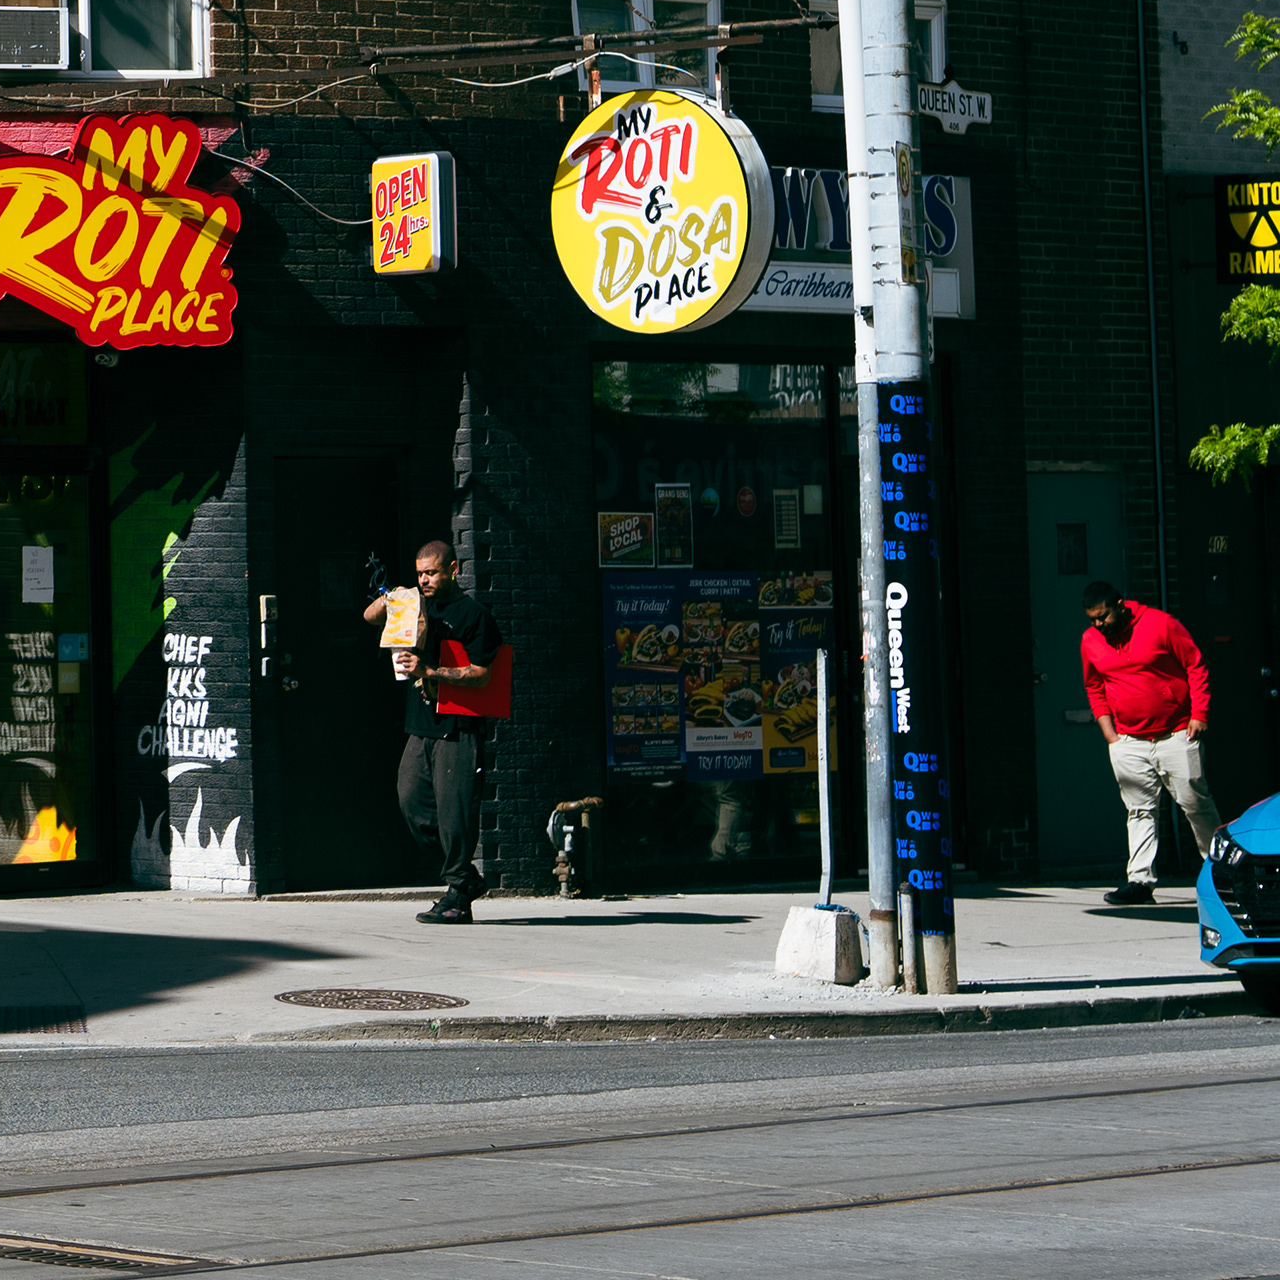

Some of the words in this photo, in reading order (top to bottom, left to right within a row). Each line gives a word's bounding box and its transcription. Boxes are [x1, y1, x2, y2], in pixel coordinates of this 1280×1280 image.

[920, 88, 955, 113] QUEEN
[959, 94, 974, 117] ST.
[977, 96, 987, 119] W.
[617, 107, 652, 140] MY
[949, 122, 959, 131] 406
[82, 125, 188, 193] MY
[571, 122, 693, 214] ROTI
[375, 162, 427, 221] OPEN
[645, 185, 672, 223] &
[380, 213, 412, 267] 24
[409, 215, 429, 234] hrs.
[599, 202, 731, 302] DOSA
[765, 270, 854, 299] Caribbean
[90, 286, 223, 336] PLACE
[610, 516, 640, 537] SHOP
[610, 528, 643, 551] LOCAL
[689, 579, 702, 587] JERK
[703, 579, 728, 587] CHICKEN
[732, 579, 751, 587] OXTAIL
[615, 600, 628, 615] Try
[639, 599, 670, 614] Today!
[767, 623, 783, 647] Try
[785, 619, 794, 640] it
[794, 616, 826, 640] Today!
[886, 581, 908, 689] Queen
[163, 633, 212, 665] CHEF
[167, 666, 206, 697] KK'S
[159, 699, 208, 727] AGNI
[896, 687, 911, 734] West
[138, 725, 238, 762] CHALLENGE
[733, 731, 752, 740] blogTO
[698, 755, 713, 770] TRY
[714, 755, 722, 769] IT
[723, 755, 752, 769] TODAY!
